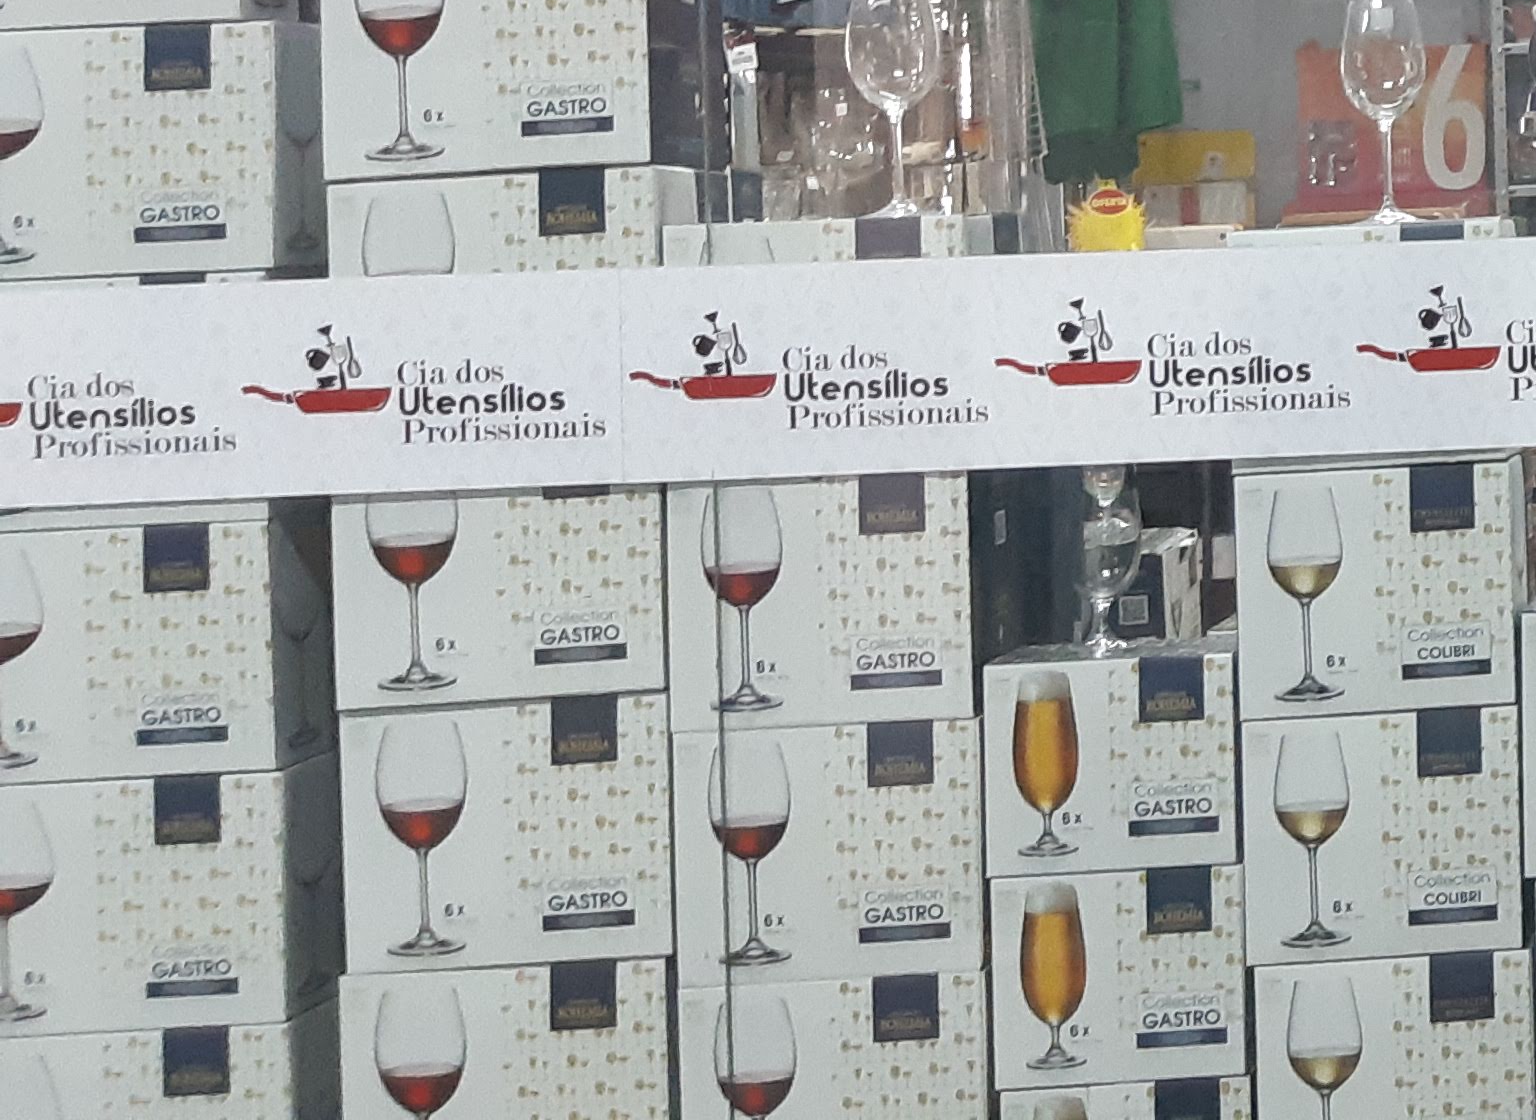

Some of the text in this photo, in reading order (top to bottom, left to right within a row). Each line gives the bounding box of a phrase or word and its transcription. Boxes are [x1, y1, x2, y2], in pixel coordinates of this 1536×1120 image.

[526, 97, 606, 117] GASTRO
[140, 205, 220, 224] GASTRO
[1148, 330, 1252, 359] Cia dos
[782, 344, 889, 372] Cia dos
[396, 358, 504, 386] Cia dos
[1150, 355, 1311, 388] Utensílios
[28, 373, 135, 400] Cia dos
[784, 370, 949, 402] Utensílios
[399, 384, 566, 416] Utensílios
[1152, 385, 1351, 416] Profissionais
[30, 398, 196, 431] Utensílios
[786, 402, 989, 430] Profissionais
[402, 414, 606, 445] Profissionais
[33, 430, 237, 460] Profissionais
[540, 625, 620, 645] GASTRO
[856, 651, 935, 670] GASTRO
[1418, 645, 1476, 660] COLIBRI
[141, 706, 221, 725] GASTRO
[1134, 798, 1212, 817] GASTRO
[549, 891, 627, 911] GASTRO
[1424, 891, 1482, 906] COLIBRI
[865, 904, 943, 923] GASTRO
[152, 959, 232, 979] GASTRO
[1142, 1009, 1220, 1028] GASTRO
